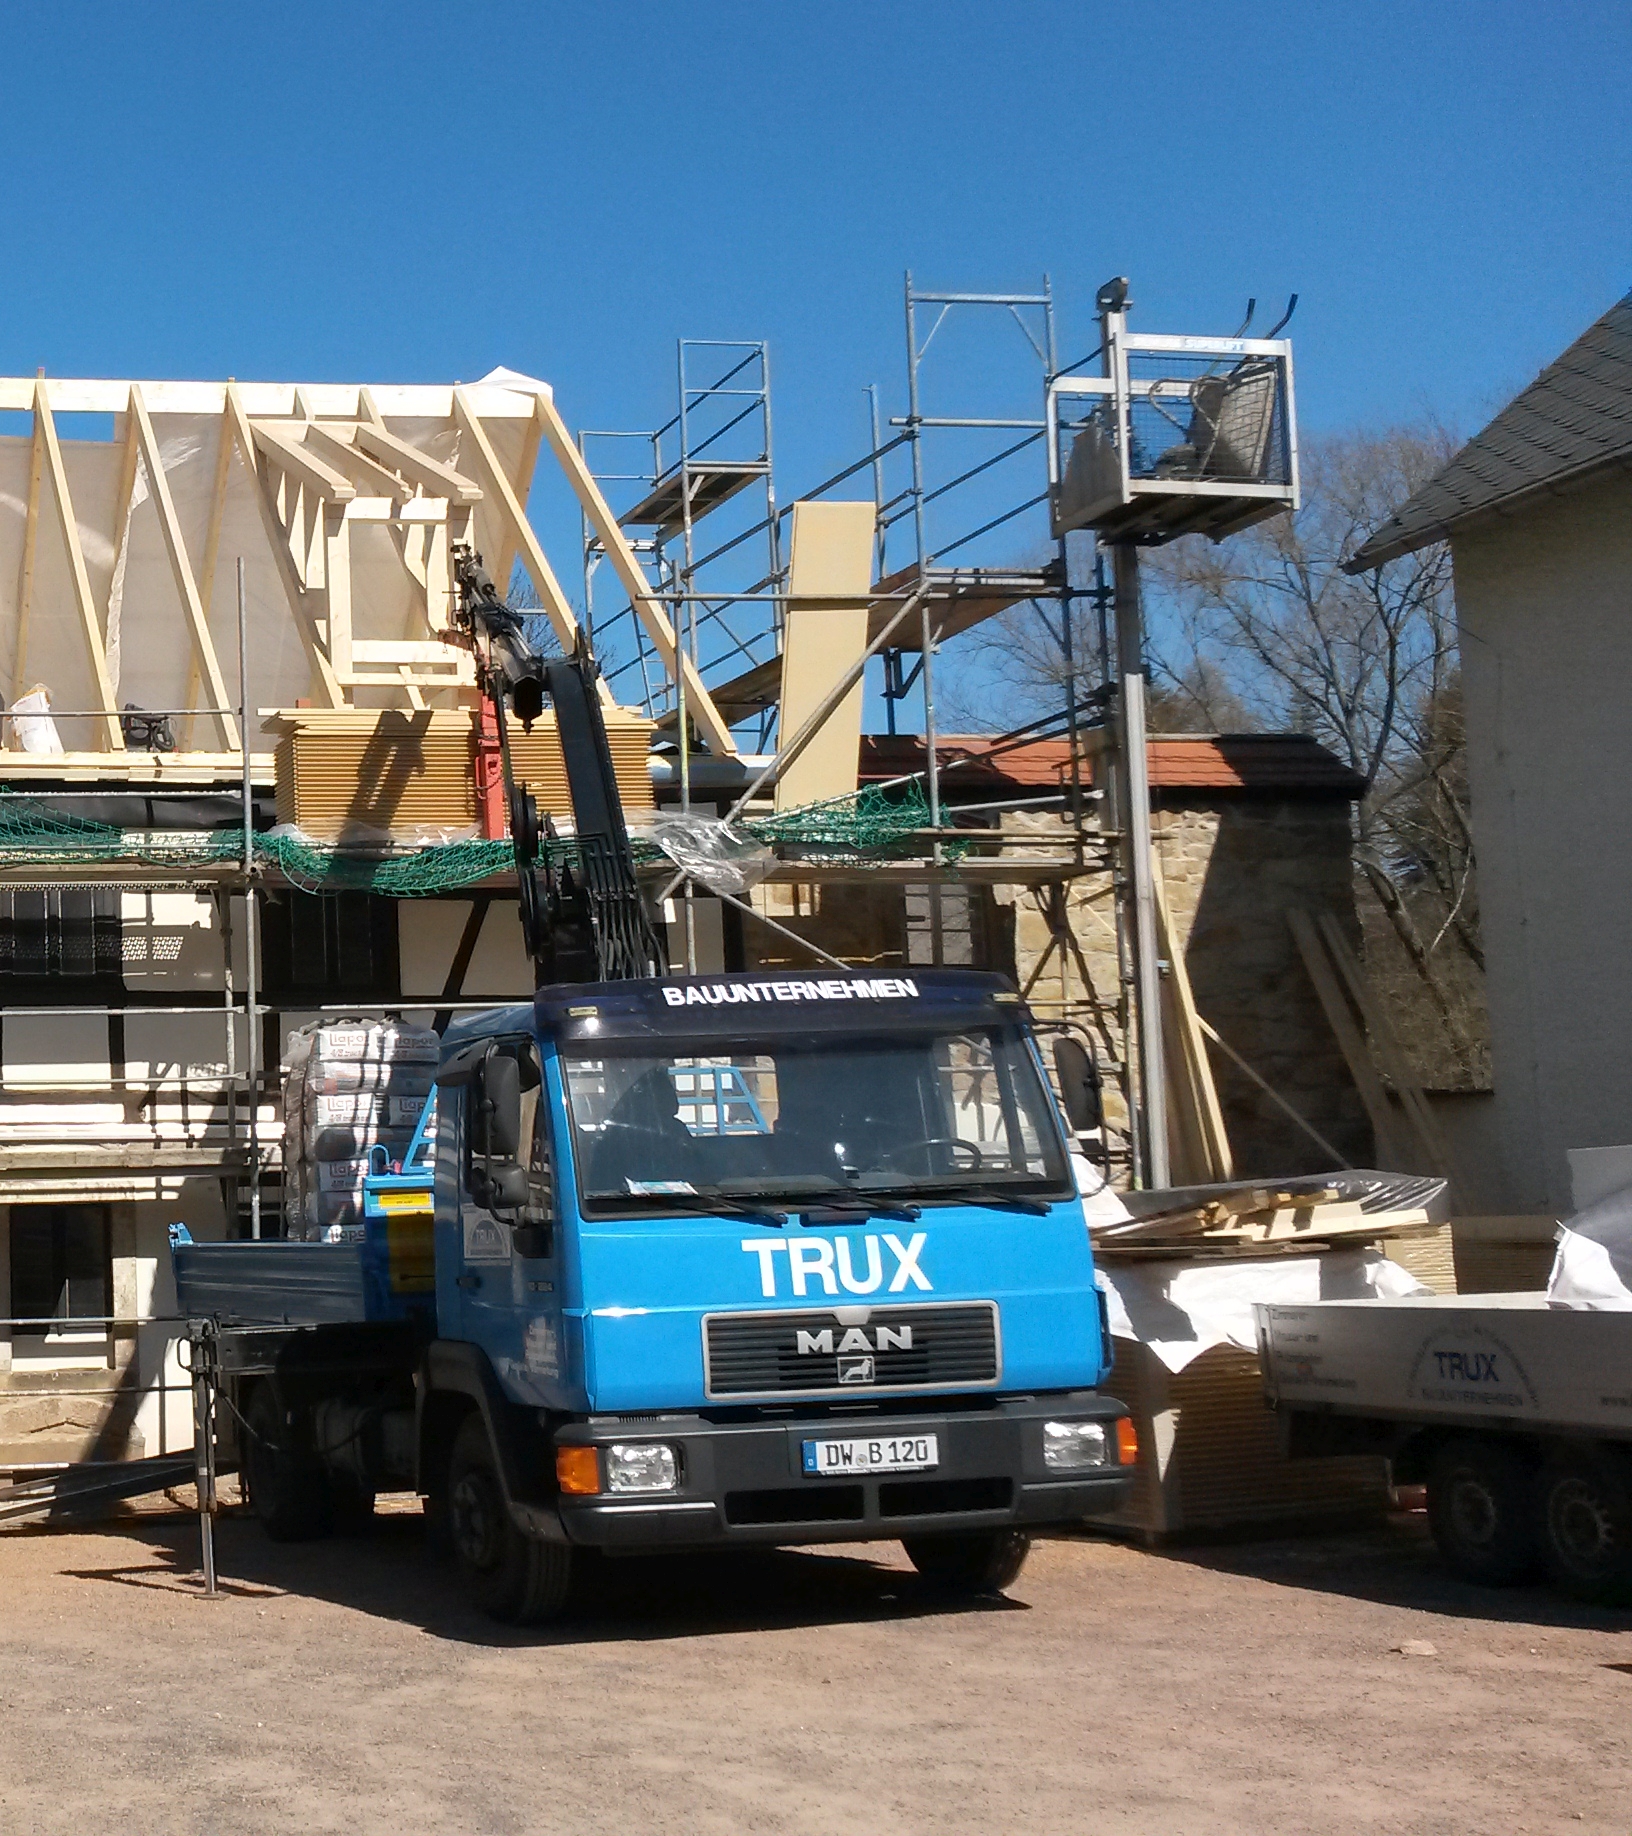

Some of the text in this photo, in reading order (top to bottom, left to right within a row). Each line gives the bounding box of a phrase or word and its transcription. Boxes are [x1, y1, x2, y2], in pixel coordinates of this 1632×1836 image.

[662, 978, 919, 1007] BAUUNTERNEHMEN
[329, 1033, 369, 1047] Liapo
[741, 1232, 934, 1297] TRUX
[796, 1326, 913, 1355] MAN
[1433, 1351, 1500, 1383] TRUX
[825, 1439, 928, 1467] DW B 120
